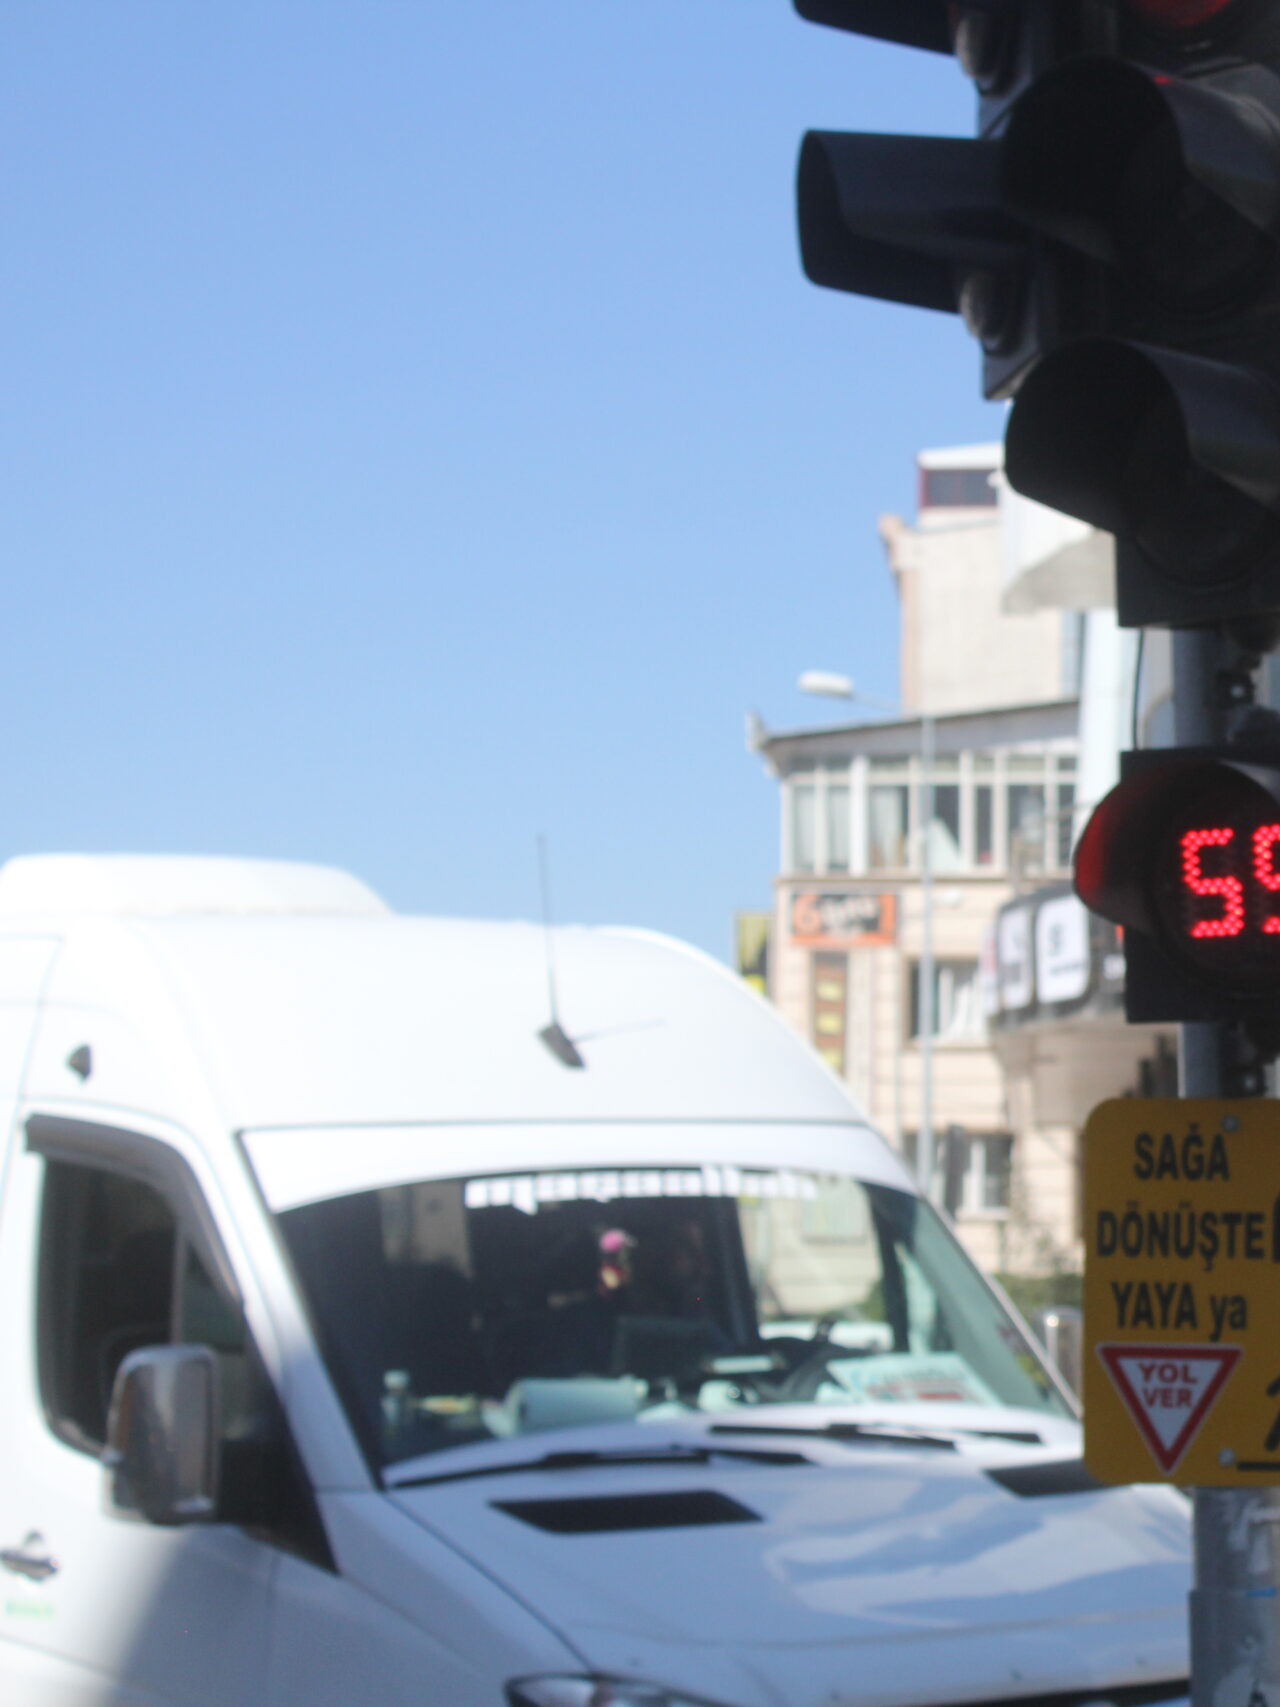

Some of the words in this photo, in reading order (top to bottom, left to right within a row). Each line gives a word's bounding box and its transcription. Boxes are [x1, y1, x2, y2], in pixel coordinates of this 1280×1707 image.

[1133, 1122, 1230, 1181] SAĞA
[1096, 1200, 1266, 1272] DÖNÜŞTE
[1111, 1281, 1198, 1330] YAYA
[1208, 1292, 1248, 1343] ya
[1138, 1363, 1198, 1385] YOL
[1142, 1387, 1193, 1410] VER
